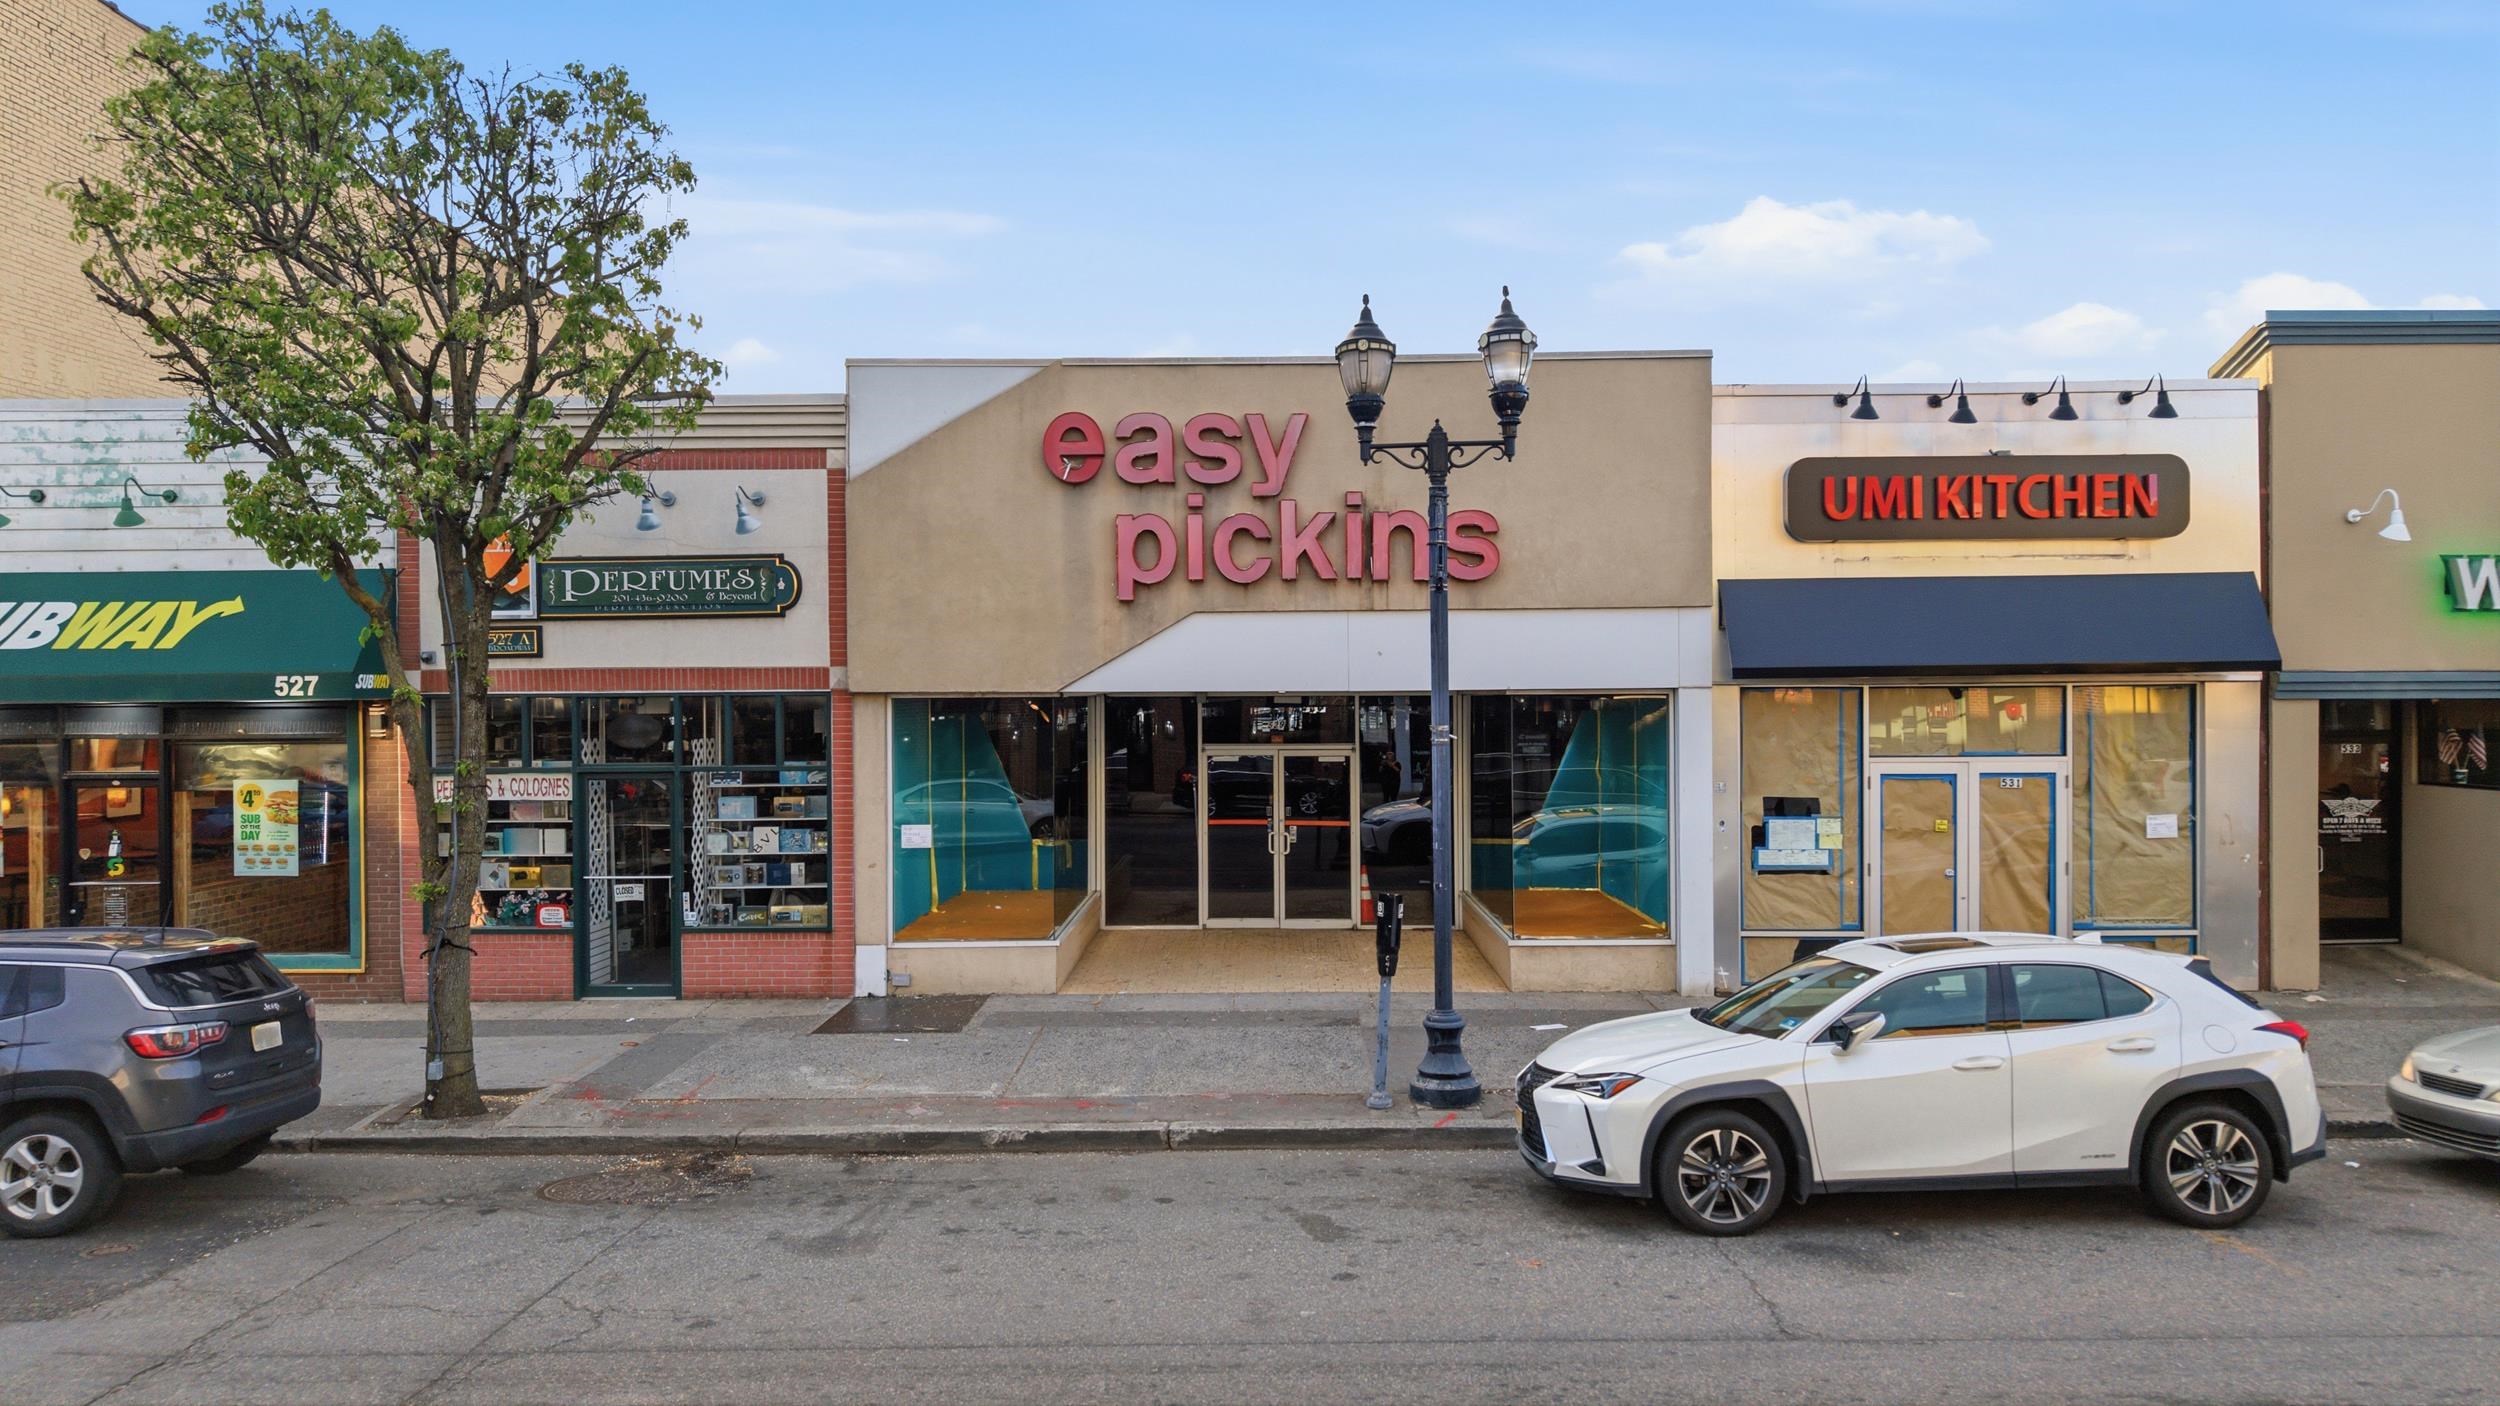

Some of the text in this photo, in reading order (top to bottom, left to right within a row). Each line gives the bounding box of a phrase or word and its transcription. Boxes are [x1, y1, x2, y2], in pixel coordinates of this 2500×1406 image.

[1042, 411, 1309, 497] easy
[1822, 472, 2159, 521] UMI KITCHEN
[1115, 491, 1501, 600] pickins
[561, 568, 755, 602] PERFUMES
[719, 591, 757, 604] Beyond
[519, 633, 530, 645] A
[274, 675, 319, 697] 527
[510, 777, 570, 797] COLOGNES
[2002, 778, 2020, 787] 531
[240, 814, 261, 824] SUB
[240, 830, 261, 841] DAY
[615, 886, 634, 896] CLOSED
